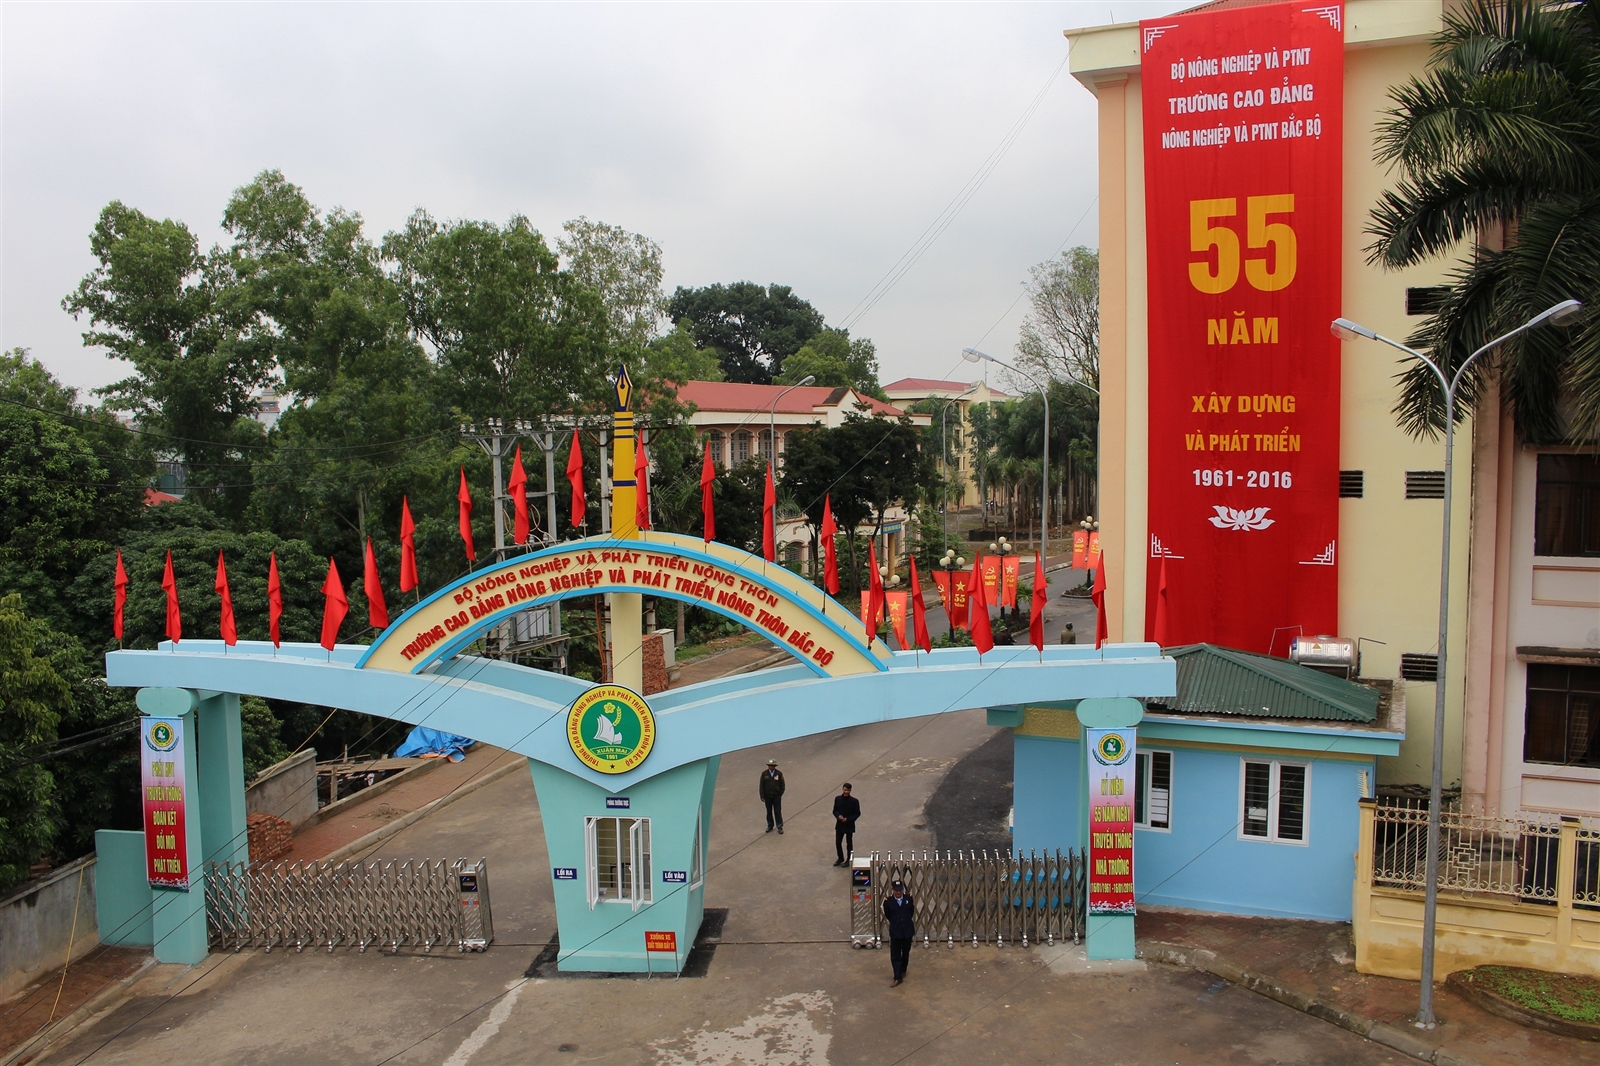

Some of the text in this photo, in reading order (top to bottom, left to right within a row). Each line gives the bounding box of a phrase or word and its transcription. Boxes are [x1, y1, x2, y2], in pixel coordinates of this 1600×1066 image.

[1171, 47, 1311, 82] BỘ NÔNG NGHIỆP VÀ PTNT
[1169, 76, 1313, 115] TRƯỜNG CAO ĐẲNG
[1162, 113, 1322, 149] NÔNG NGHIỆP VÀ PTNT BẮC BỘ
[1188, 193, 1297, 294] 55
[1207, 310, 1279, 345] NĂM
[1192, 391, 1296, 417] XÂY DỰNG
[1185, 426, 1300, 452] VÀ PHÁT TRIỂN
[453, 550, 779, 608] BỘ NÔNG NGHIỆP VÀ PHÁT TRIỂN NÔNG THÔN
[954, 593, 966, 603] 55
[400, 566, 835, 667] TRƯỜNG CAO ĐẲNG NÔNG NGHIỆP VÀ PHÁT TRIỂN NÔNG THÔN BẮC BỘ
[152, 758, 164, 777] PHÁT
[146, 781, 182, 802] TRUYỀN THỐNG
[1109, 775, 1124, 799] NIỆM
[153, 806, 177, 826] ĐOÀN KẾT
[1094, 802, 1131, 822] 55 NĂM NGÀY
[166, 831, 176, 850] MỚI
[1093, 827, 1132, 849] TRUYỀN THỐNG
[154, 853, 181, 874] PHÁT TRIỂN
[674, 871, 685, 879] VÀO
[1096, 855, 1130, 876] NHÀ TRƯỜNG
